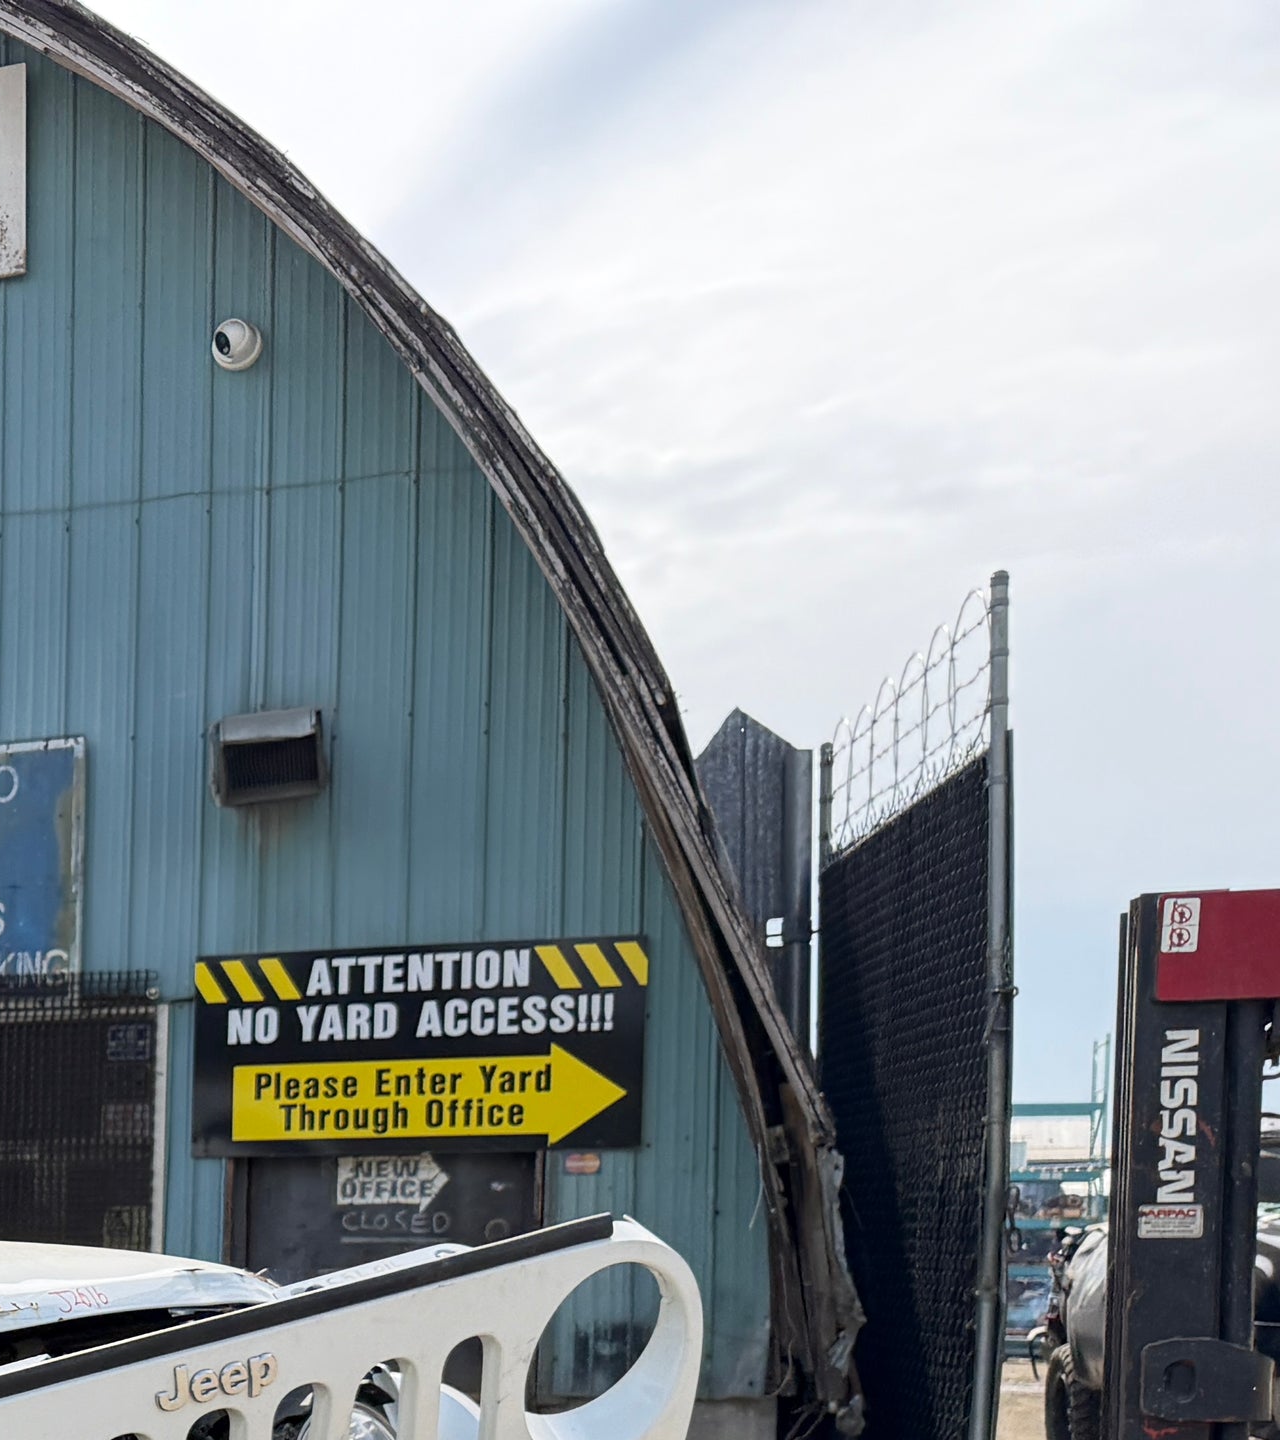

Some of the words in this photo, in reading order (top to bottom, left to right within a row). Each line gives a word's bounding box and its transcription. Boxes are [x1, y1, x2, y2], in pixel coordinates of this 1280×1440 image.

[306, 948, 531, 997] ATTENTION
[227, 1008, 279, 1046] NO
[297, 1003, 398, 1042] YARD
[416, 993, 615, 1038] ACCESS!!!
[254, 1071, 358, 1101] Please
[375, 1067, 462, 1097] Enter
[479, 1063, 552, 1094] Yard
[279, 1103, 409, 1134] Through
[425, 1101, 524, 1129] Office
[1157, 1029, 1199, 1203] NISSAN
[354, 1160, 419, 1178] NEW
[341, 1180, 433, 1199] OFFICE
[342, 1211, 451, 1234] CLOSED
[155, 1352, 278, 1412] Jeep
